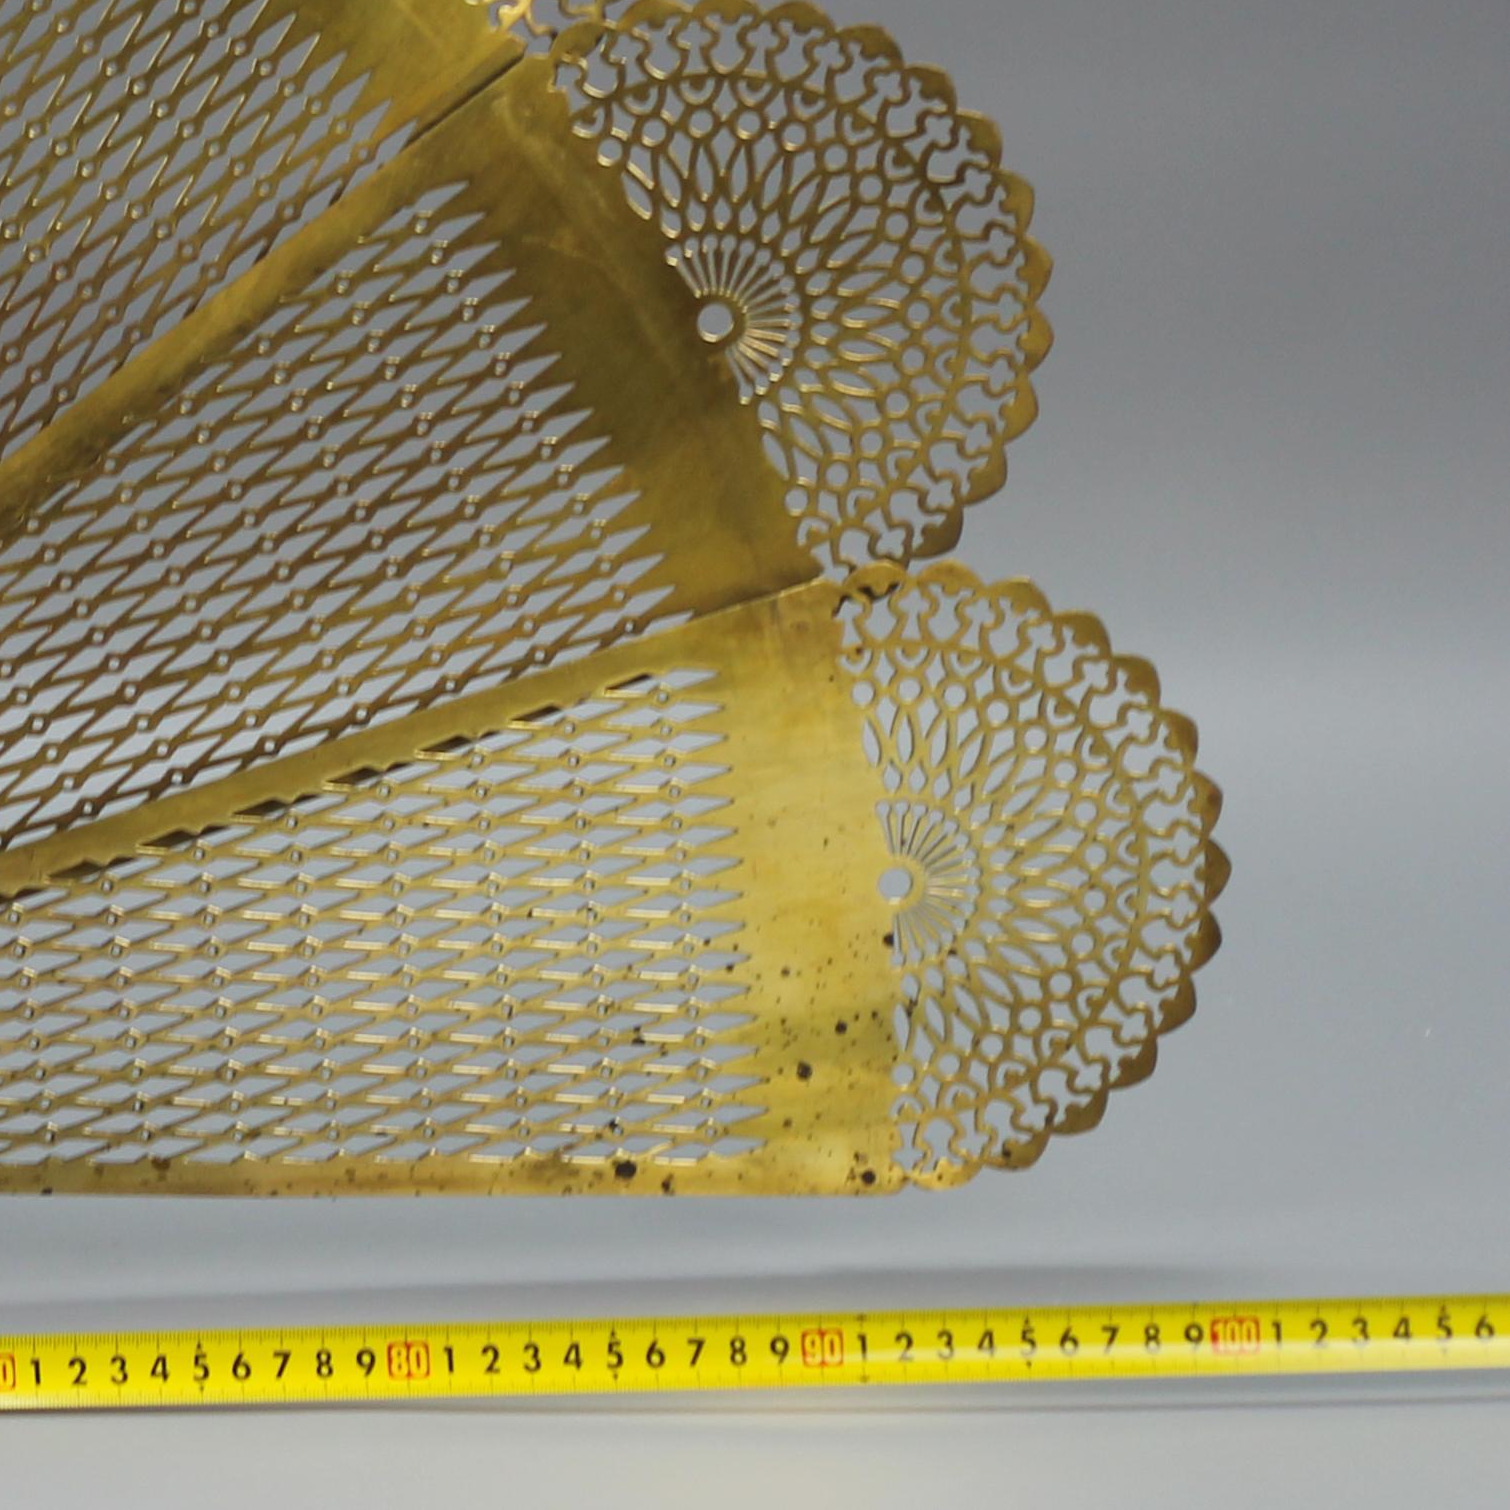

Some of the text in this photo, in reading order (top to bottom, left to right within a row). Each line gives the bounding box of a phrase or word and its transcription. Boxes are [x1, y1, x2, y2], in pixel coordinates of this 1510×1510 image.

[31, 1359, 41, 1386] 1
[69, 1357, 86, 1385] 2
[111, 1354, 128, 1384] 3
[151, 1355, 169, 1382] 4
[194, 1352, 209, 1382] 5
[232, 1352, 251, 1380] 6
[274, 1351, 291, 1378] 7
[316, 1349, 333, 1378] 8
[356, 1348, 376, 1377] 9
[388, 1344, 429, 1379] 80
[444, 1346, 454, 1373] 1
[482, 1344, 500, 1373] 2
[524, 1342, 541, 1373] 3
[564, 1342, 582, 1370] 4
[607, 1341, 623, 1371] 5
[646, 1340, 665, 1368] 6
[688, 1338, 705, 1367] 7
[730, 1336, 747, 1366] 8
[770, 1335, 789, 1364] 9
[801, 1331, 843, 1366] 90
[857, 1333, 867, 1360] 1
[895, 1331, 913, 1360] 2
[937, 1329, 954, 1360] 3
[977, 1329, 995, 1356] 4
[1021, 1328, 1036, 1356] 5
[1060, 1327, 1079, 1354] 6
[1101, 1325, 1119, 1353] 7
[1144, 1323, 1160, 1351] 8
[1184, 1323, 1204, 1350] 9
[1211, 1318, 1260, 1352] 100
[1272, 1320, 1282, 1347] 1
[1310, 1318, 1328, 1347] 2
[1352, 1317, 1369, 1346] 3
[1393, 1316, 1412, 1343] 4
[1437, 1317, 1453, 1343] 5
[1474, 1315, 1495, 1343] 6
